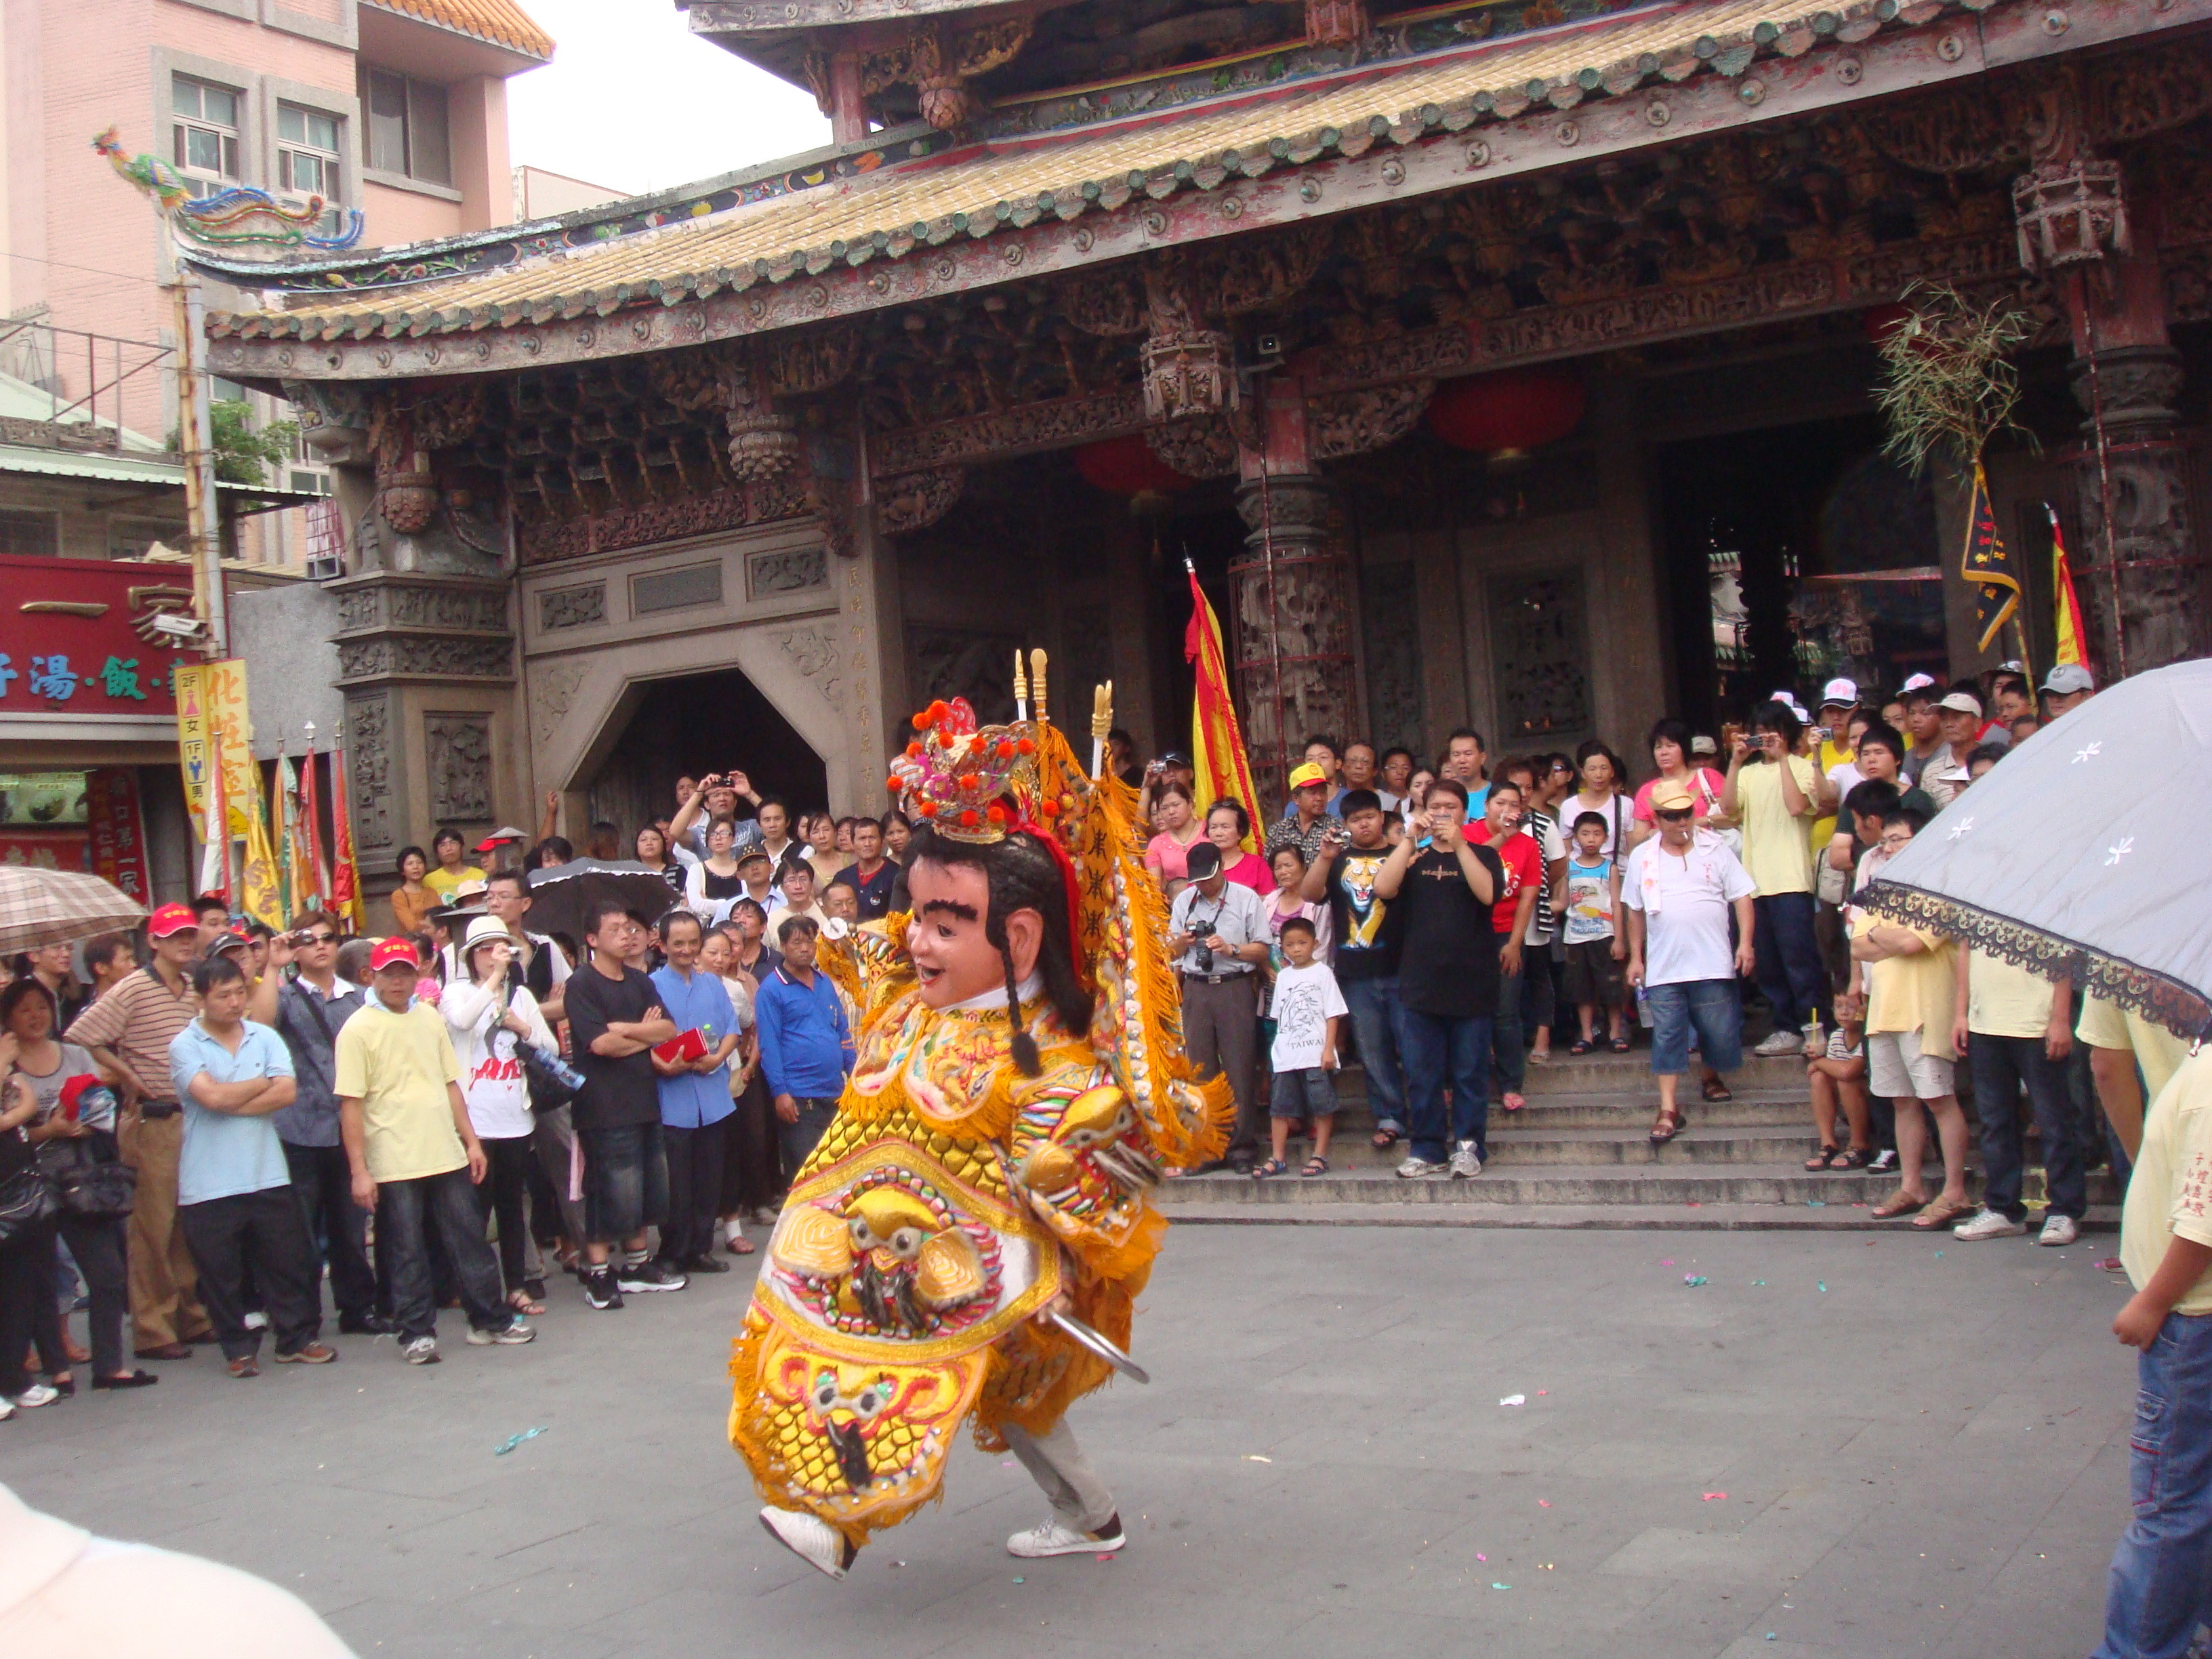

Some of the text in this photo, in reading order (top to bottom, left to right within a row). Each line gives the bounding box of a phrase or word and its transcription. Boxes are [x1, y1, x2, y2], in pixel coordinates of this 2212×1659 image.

[182, 676, 196, 687] 2F
[186, 719, 198, 733] 女
[186, 744, 201, 754] 1F
[192, 785, 203, 798] 男
